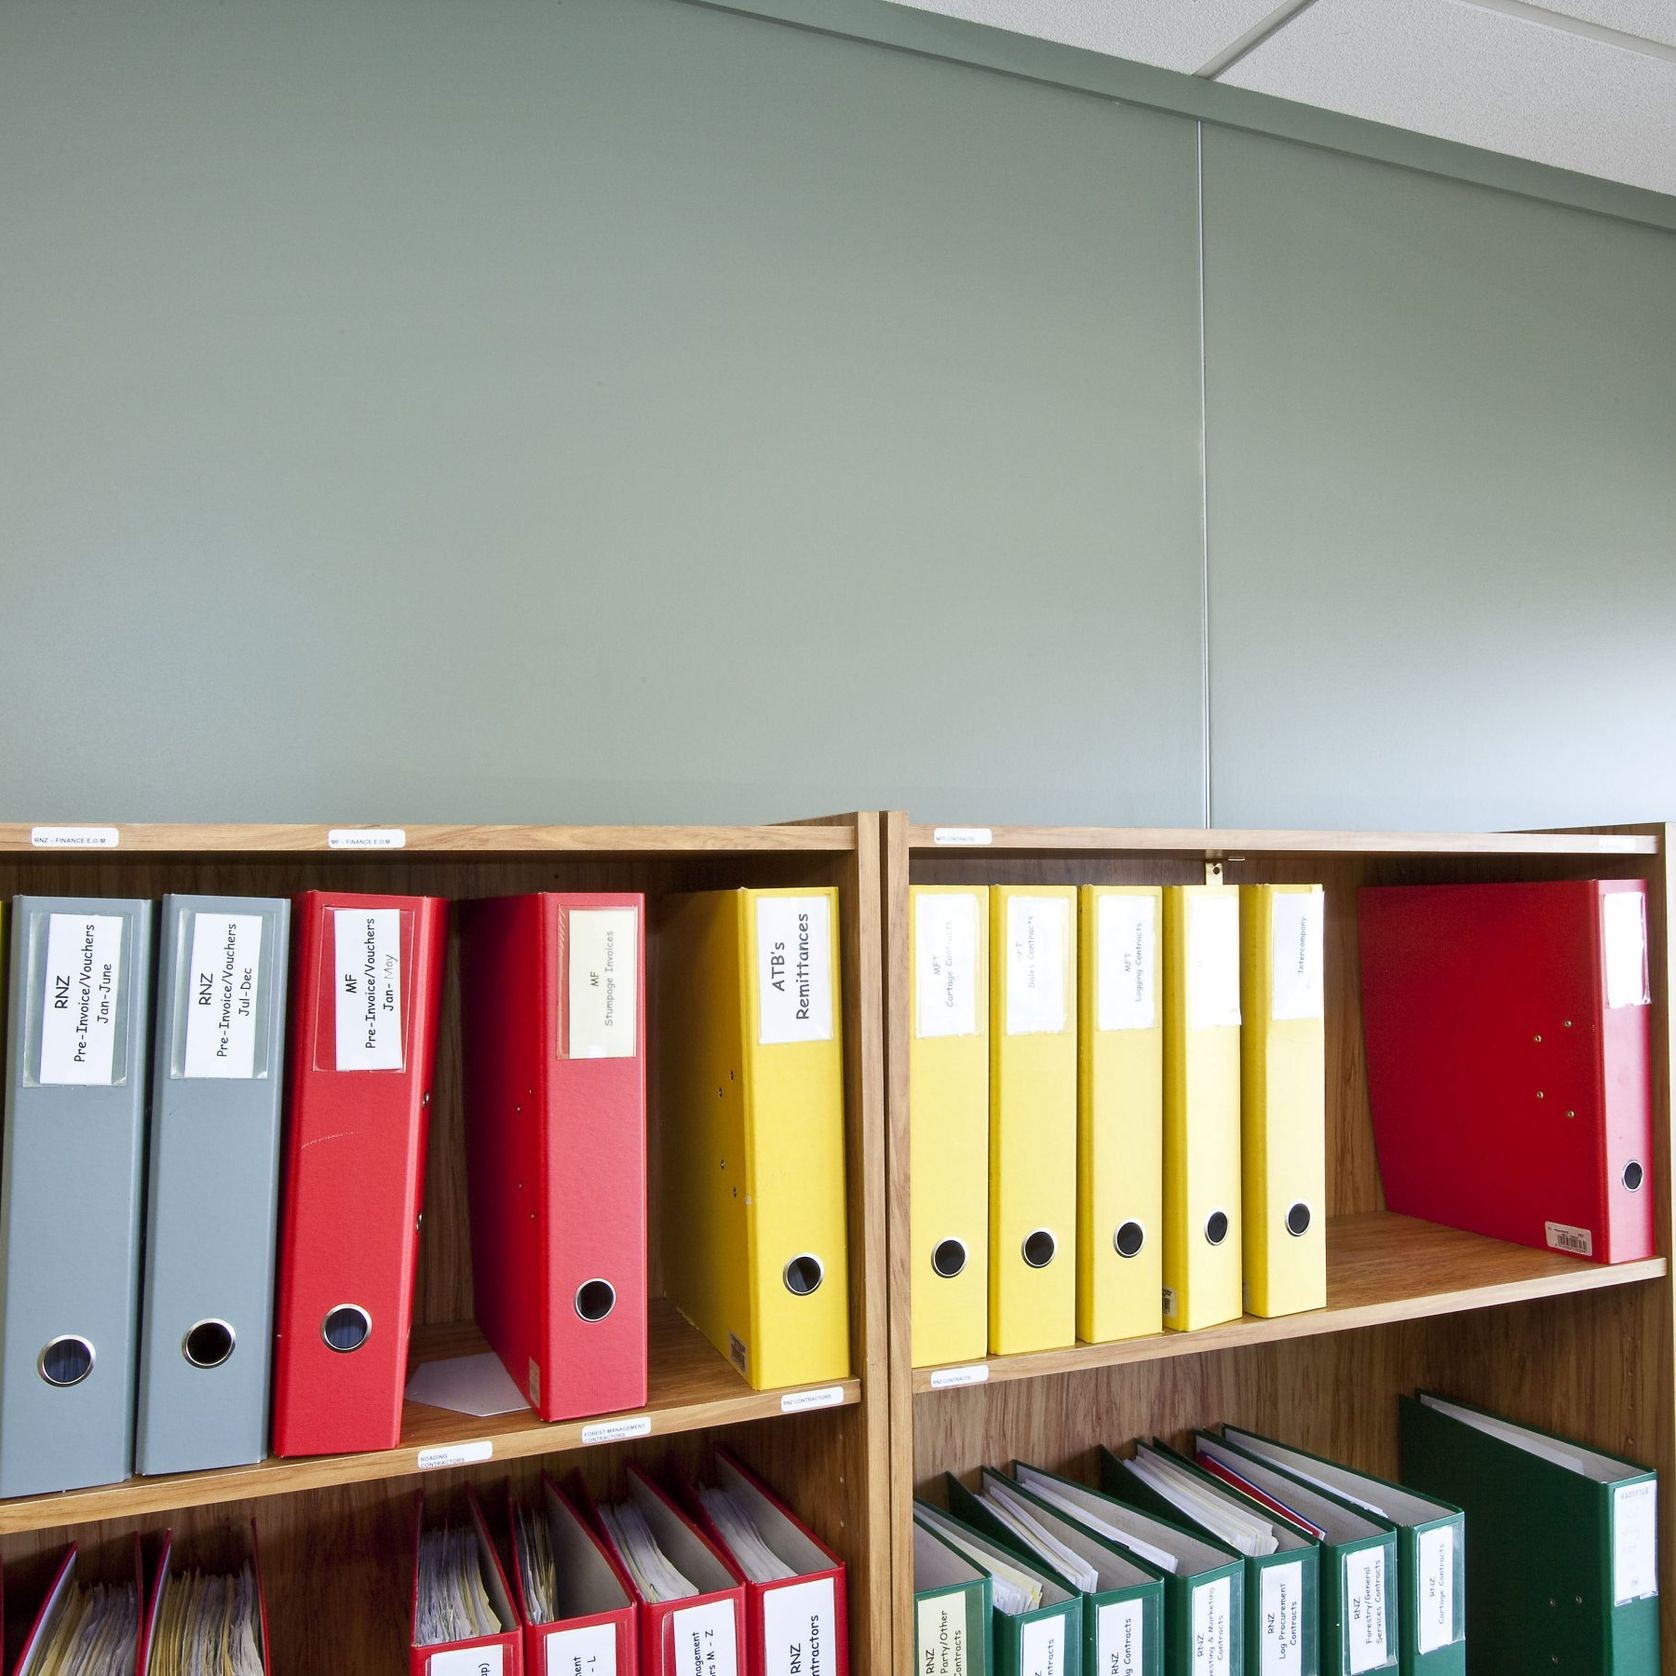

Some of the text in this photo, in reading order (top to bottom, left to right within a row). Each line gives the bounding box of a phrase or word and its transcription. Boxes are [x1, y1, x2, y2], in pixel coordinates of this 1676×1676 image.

[1135, 922, 1143, 1002] Logging Contracts
[1297, 917, 1307, 974] Intercompany
[383, 954, 398, 979] May
[590, 971, 600, 987] MF
[605, 931, 616, 1027] Stumpage Invoices
[770, 941, 785, 992] ATB's
[795, 913, 810, 1020] Remittances
[932, 954, 941, 976] MFT
[1124, 953, 1132, 973] MFT
[54, 975, 71, 1009] RNZ
[73, 924, 95, 1062] Pre-Invoice/Vouchers
[97, 963, 112, 1024] Jan-June
[198, 972, 214, 1006] RNZ
[216, 924, 237, 1057] Pre-Invoice/Vouchers
[238, 968, 253, 1017] Jul-Dec
[344, 974, 358, 994] MF
[364, 918, 376, 1049] Pre-Invoice/Vouchers
[945, 969, 956, 1008] Cartage
[794, 1393, 832, 1404] CONTRACTORS
[584, 1423, 645, 1437] FOREST MANAGEMENT
[584, 1432, 626, 1443] CONTRACTORS
[420, 1453, 447, 1462] ROADING
[420, 1457, 465, 1468] CONTRACTORS
[1208, 1587, 1216, 1633] Marketing
[1278, 1583, 1287, 1660] Log Procurement
[1353, 1597, 1361, 1620] RNZ
[1364, 1566, 1373, 1645] Forestry/General
[1438, 1590, 1446, 1625] Cartage
[705, 1629, 713, 1638] Z
[1267, 1612, 1275, 1635] RNZ
[939, 1610, 950, 1674] Party/Other
[1123, 1617, 1132, 1665] Contracts
[1197, 1632, 1205, 1658] RNZ
[790, 1642, 802, 1675] RNZ
[925, 1647, 935, 1675] RNZ
[1111, 1651, 1119, 1675] RNZ
